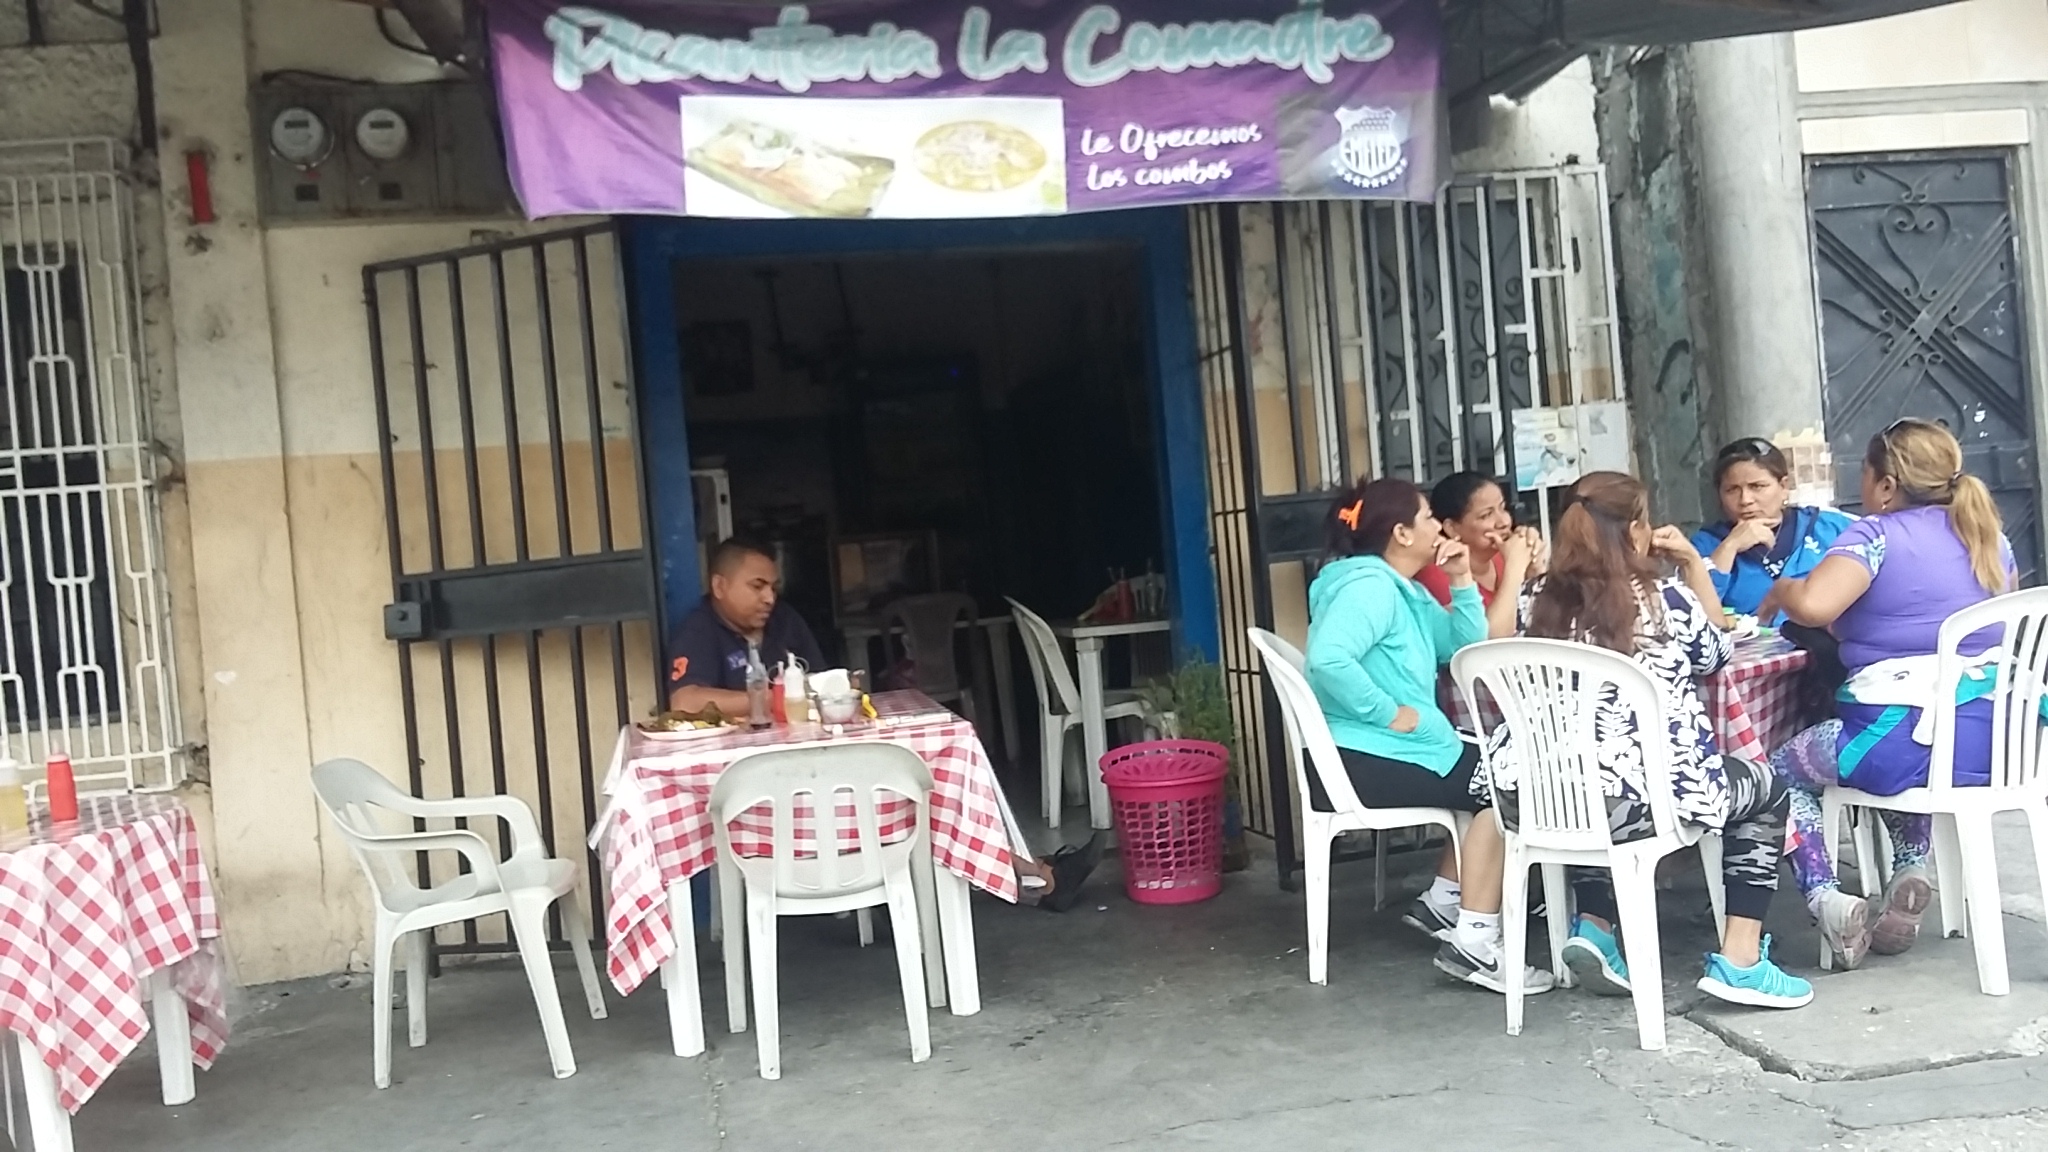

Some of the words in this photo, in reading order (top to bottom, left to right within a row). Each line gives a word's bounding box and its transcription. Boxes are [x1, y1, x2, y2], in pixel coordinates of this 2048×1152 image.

[957, 6, 1048, 81] La
[1063, 0, 1394, 87] Comadre
[1081, 128, 1114, 155] Le
[1119, 122, 1262, 161] Ofrecemos
[1087, 162, 1128, 190] Los
[1134, 158, 1233, 185] combos
